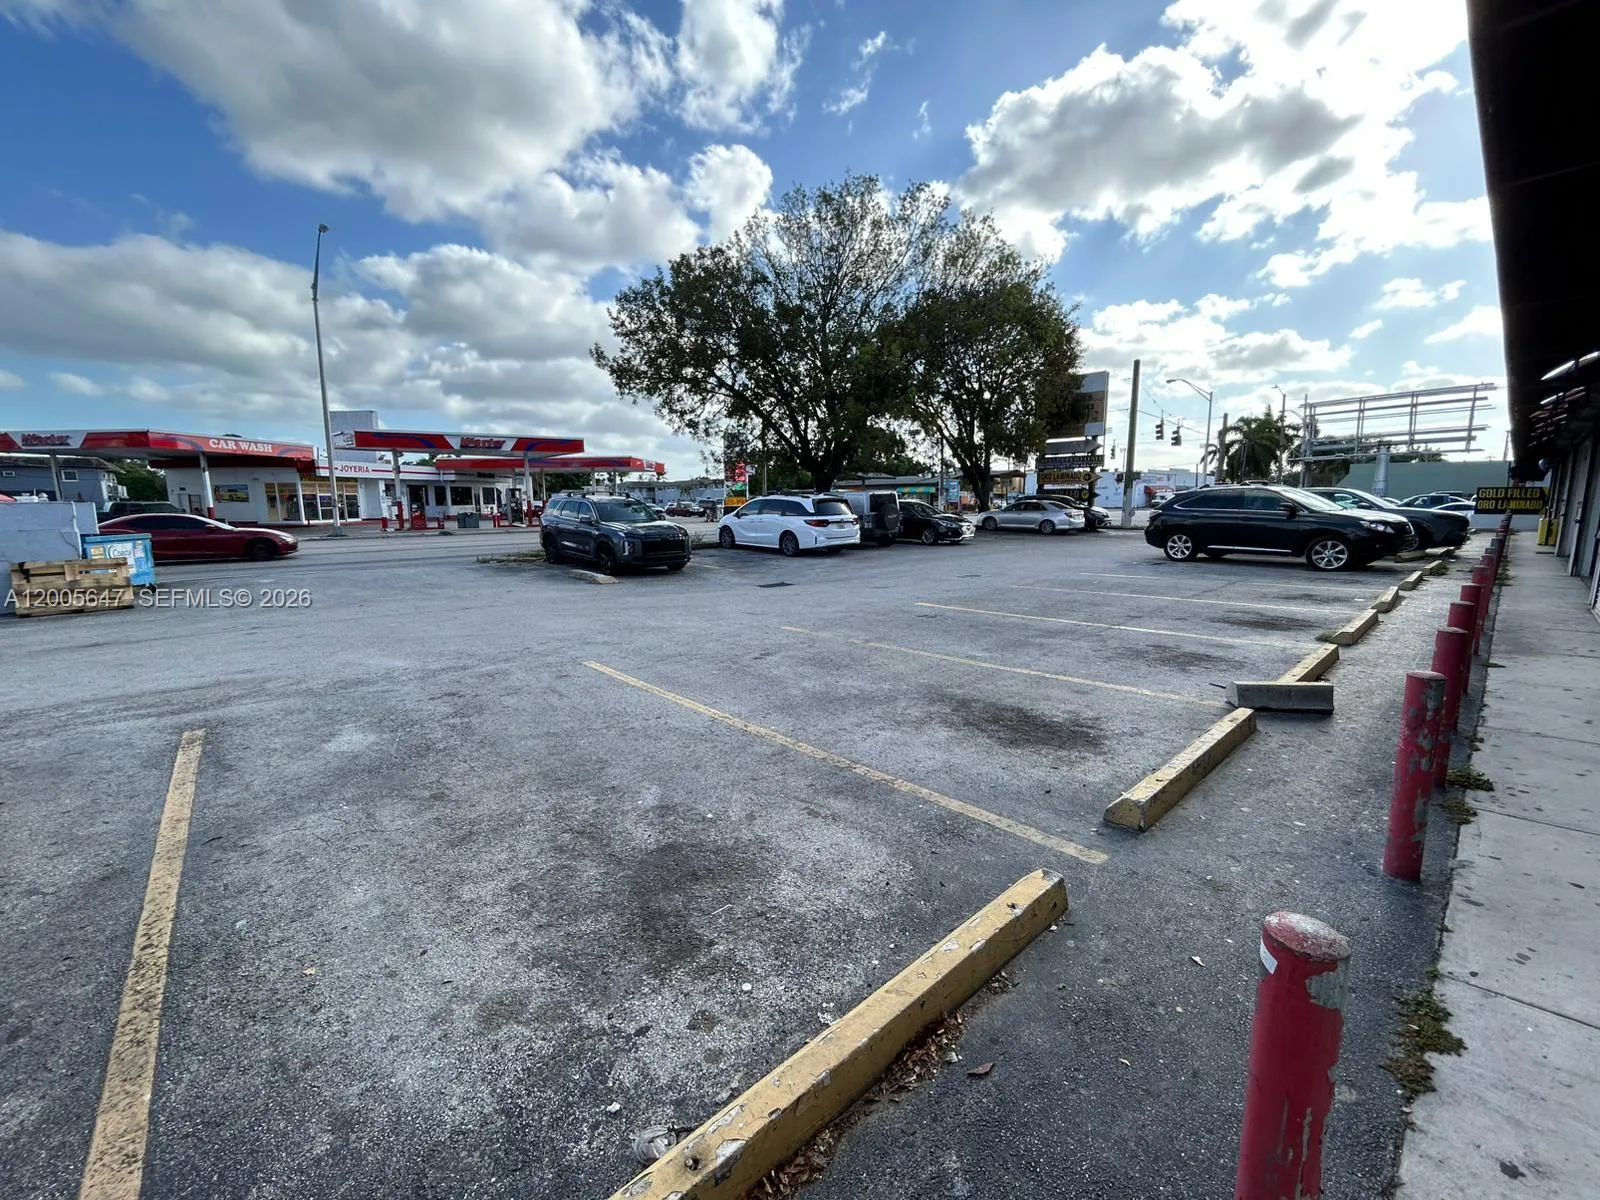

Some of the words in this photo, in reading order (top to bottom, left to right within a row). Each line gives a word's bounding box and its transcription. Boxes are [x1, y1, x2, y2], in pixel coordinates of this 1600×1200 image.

[209, 439, 237, 449] CAR
[238, 441, 273, 453] WASH
[339, 465, 370, 473] JOYERIA
[1478, 488, 1505, 498] GOLD
[1507, 488, 1541, 498] FILLED
[1477, 499, 1496, 509] ORO
